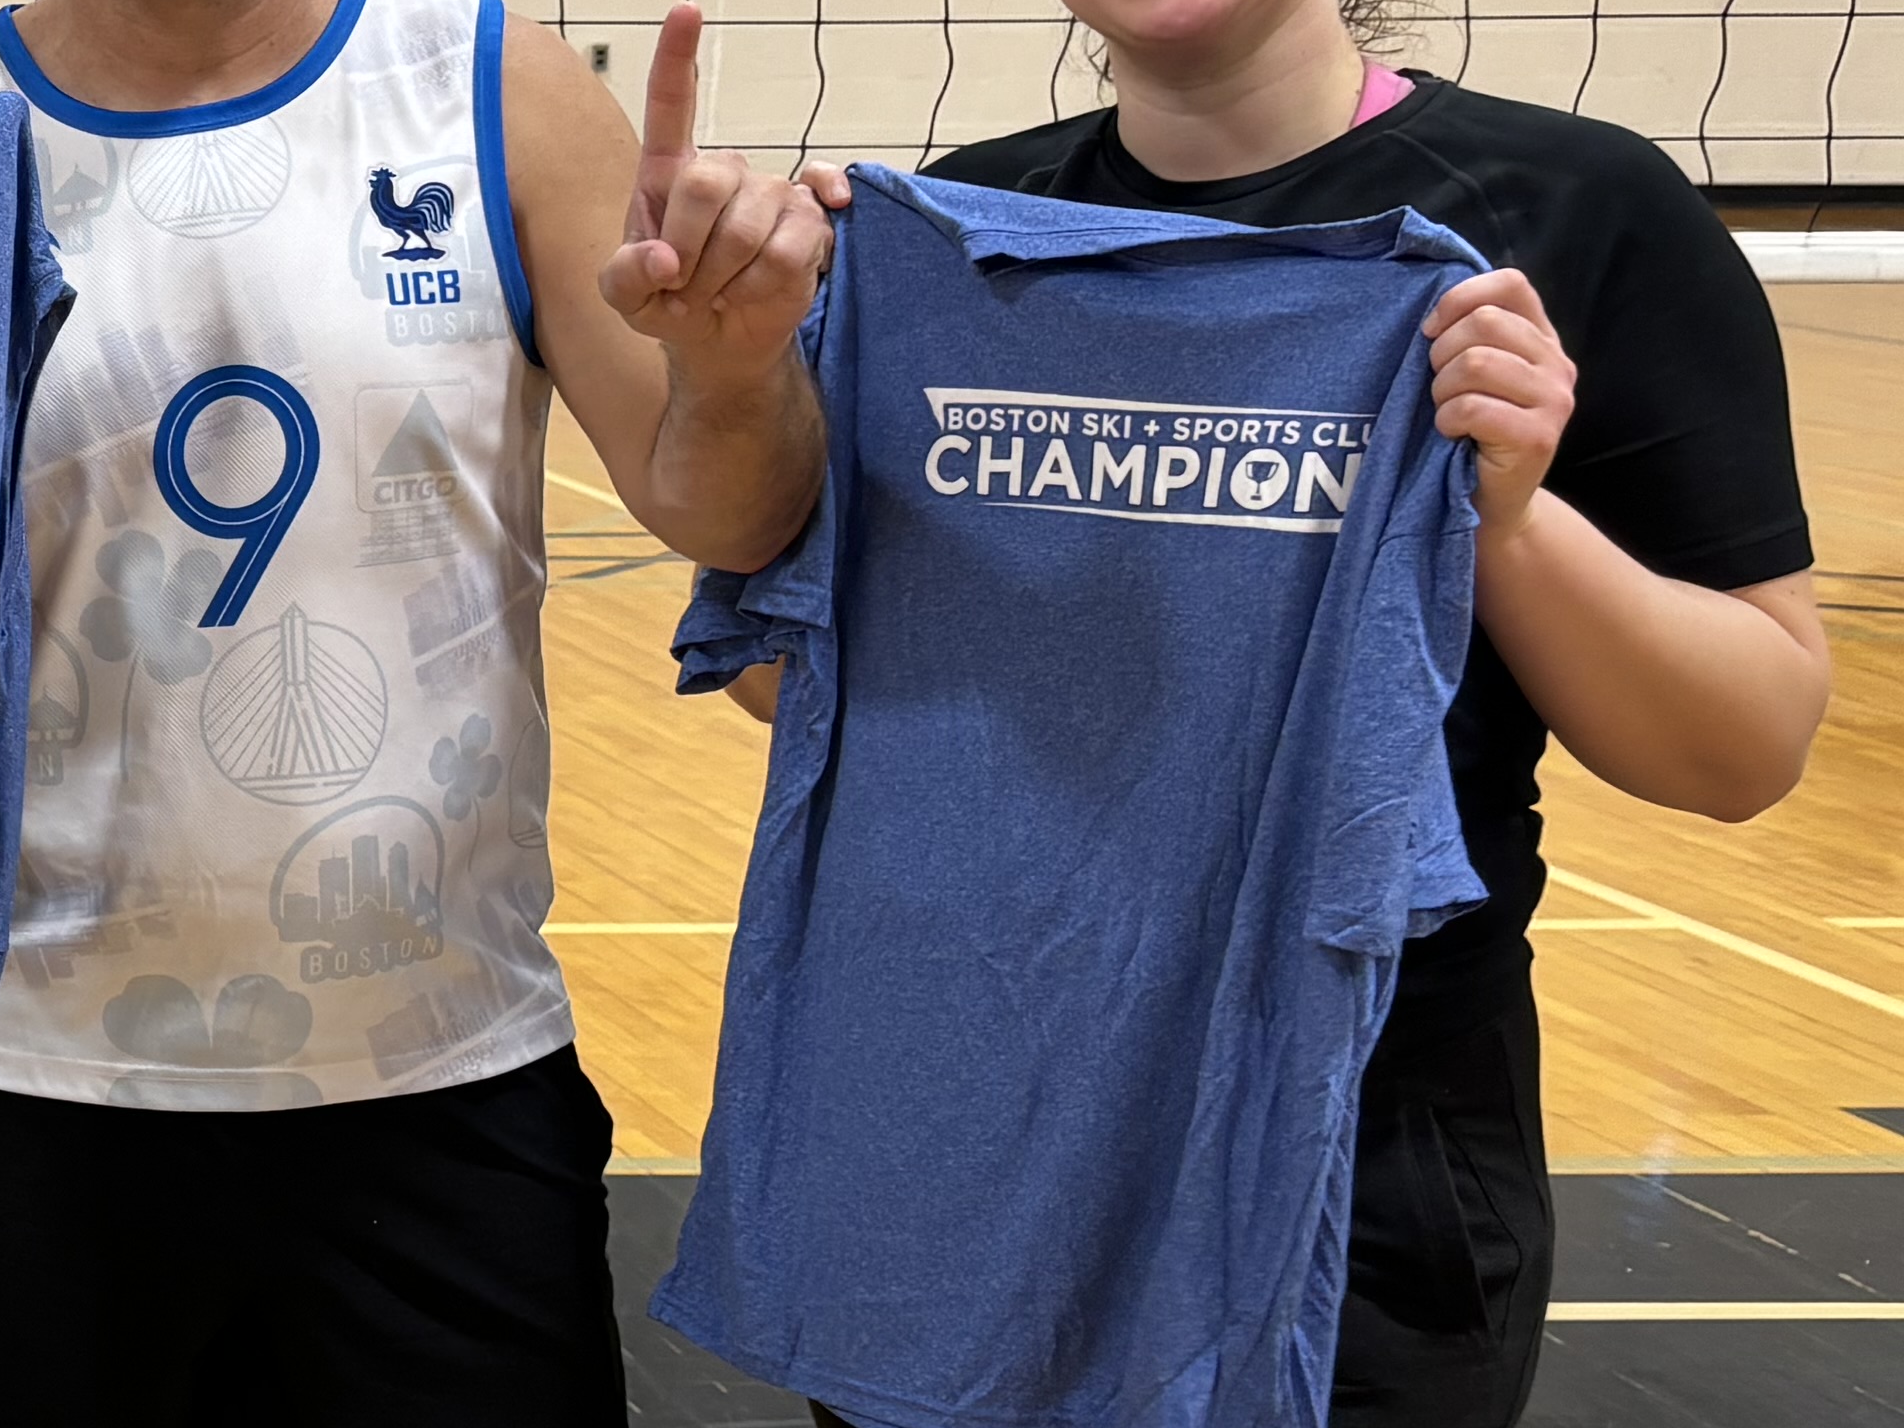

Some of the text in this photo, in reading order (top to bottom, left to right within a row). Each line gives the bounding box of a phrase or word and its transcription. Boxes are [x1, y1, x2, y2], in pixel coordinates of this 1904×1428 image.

[386, 269, 461, 305] UCB
[394, 309, 502, 337] BOSTO
[948, 407, 1070, 434] BOSTON
[1082, 414, 1131, 439] SKI
[1173, 417, 1300, 445] SPORTS
[374, 475, 457, 505] CITGO
[924, 434, 1363, 513] CHAMPION
[153, 364, 320, 628] 9
[310, 936, 438, 976] BOSTON
